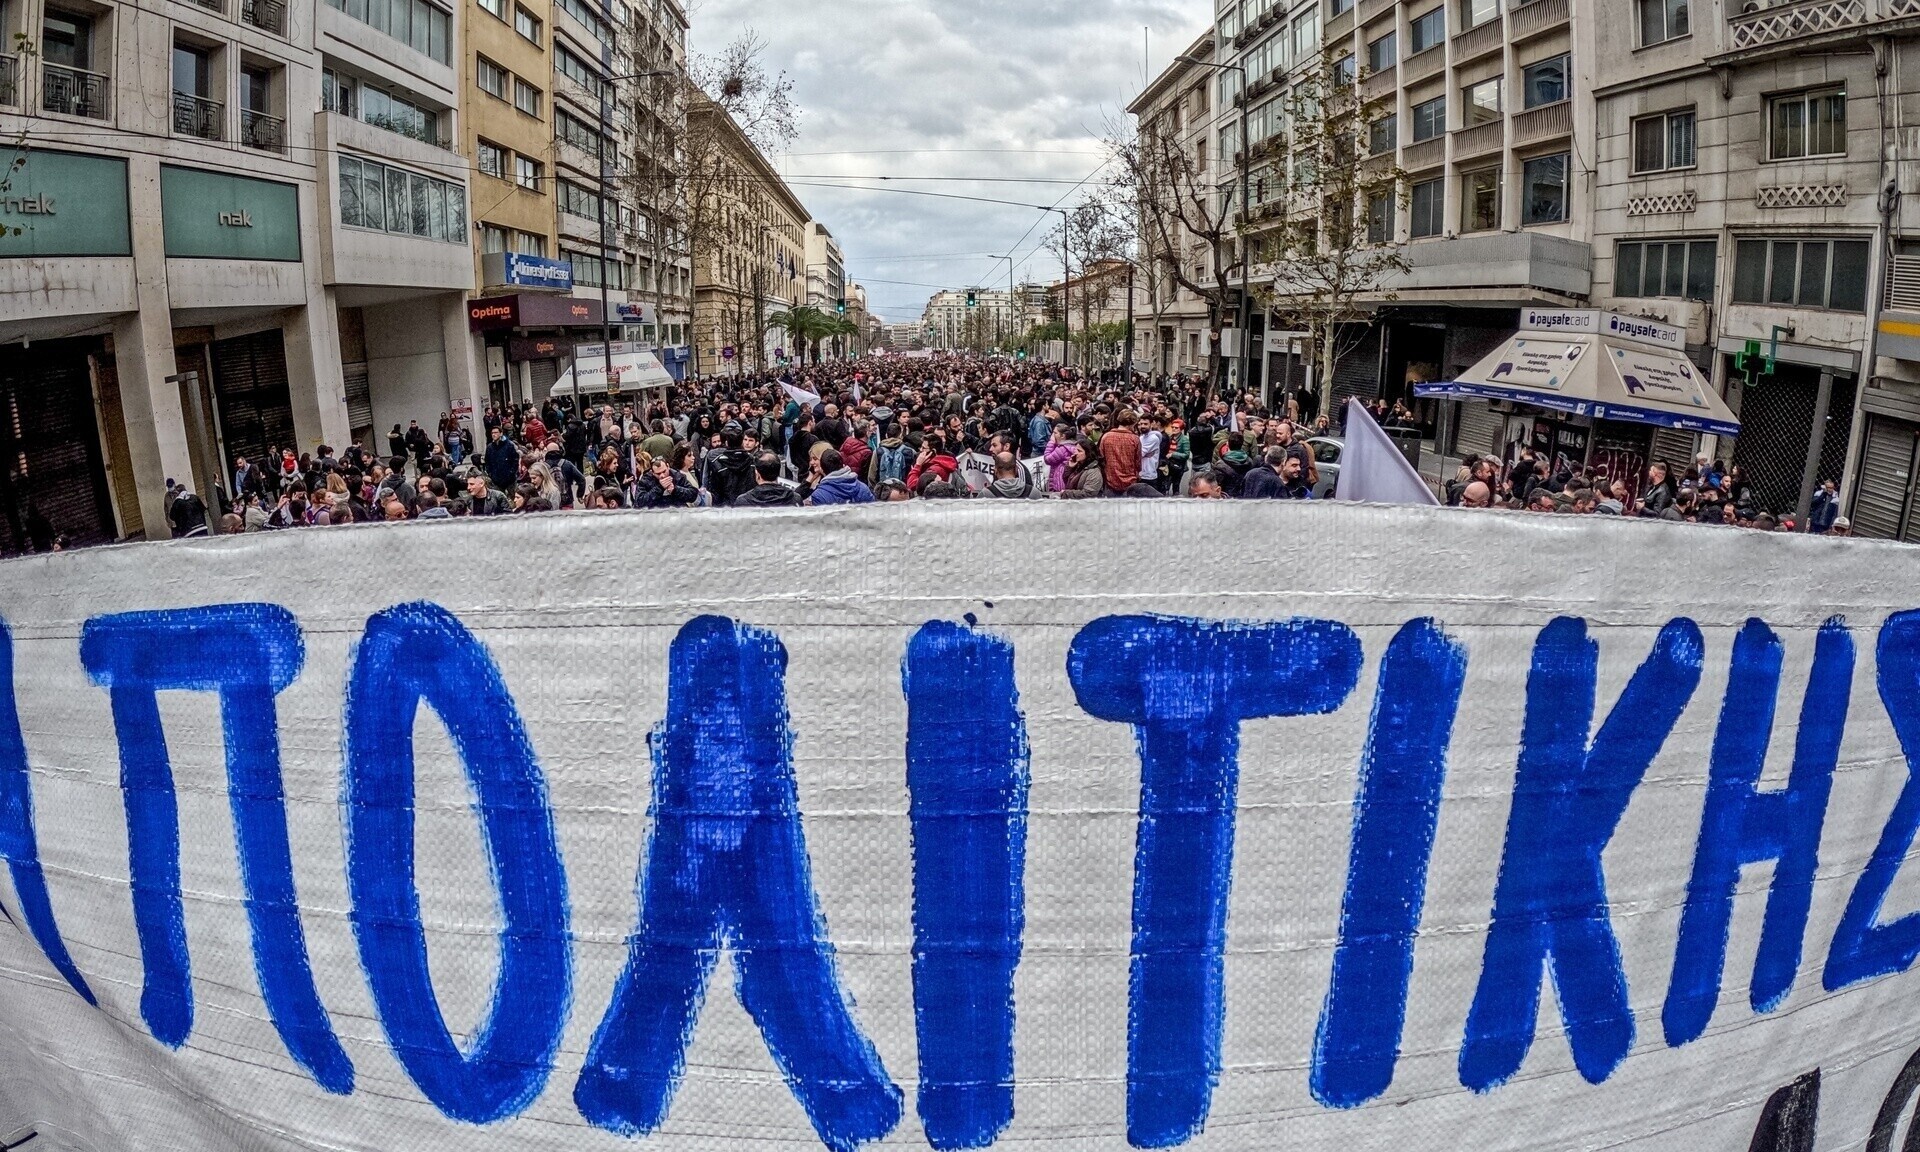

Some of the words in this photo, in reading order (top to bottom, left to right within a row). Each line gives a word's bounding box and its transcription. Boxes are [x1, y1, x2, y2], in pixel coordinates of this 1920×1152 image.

[219, 209, 253, 227] nak
[518, 261, 547, 281] University
[554, 267, 570, 281] Essex
[471, 305, 510, 319] Optima
[571, 305, 588, 316] Optima
[1536, 313, 1590, 327] paysafecard
[1619, 320, 1677, 342] paysafecard
[536, 342, 554, 354] Optima
[565, 368, 598, 377] Agean
